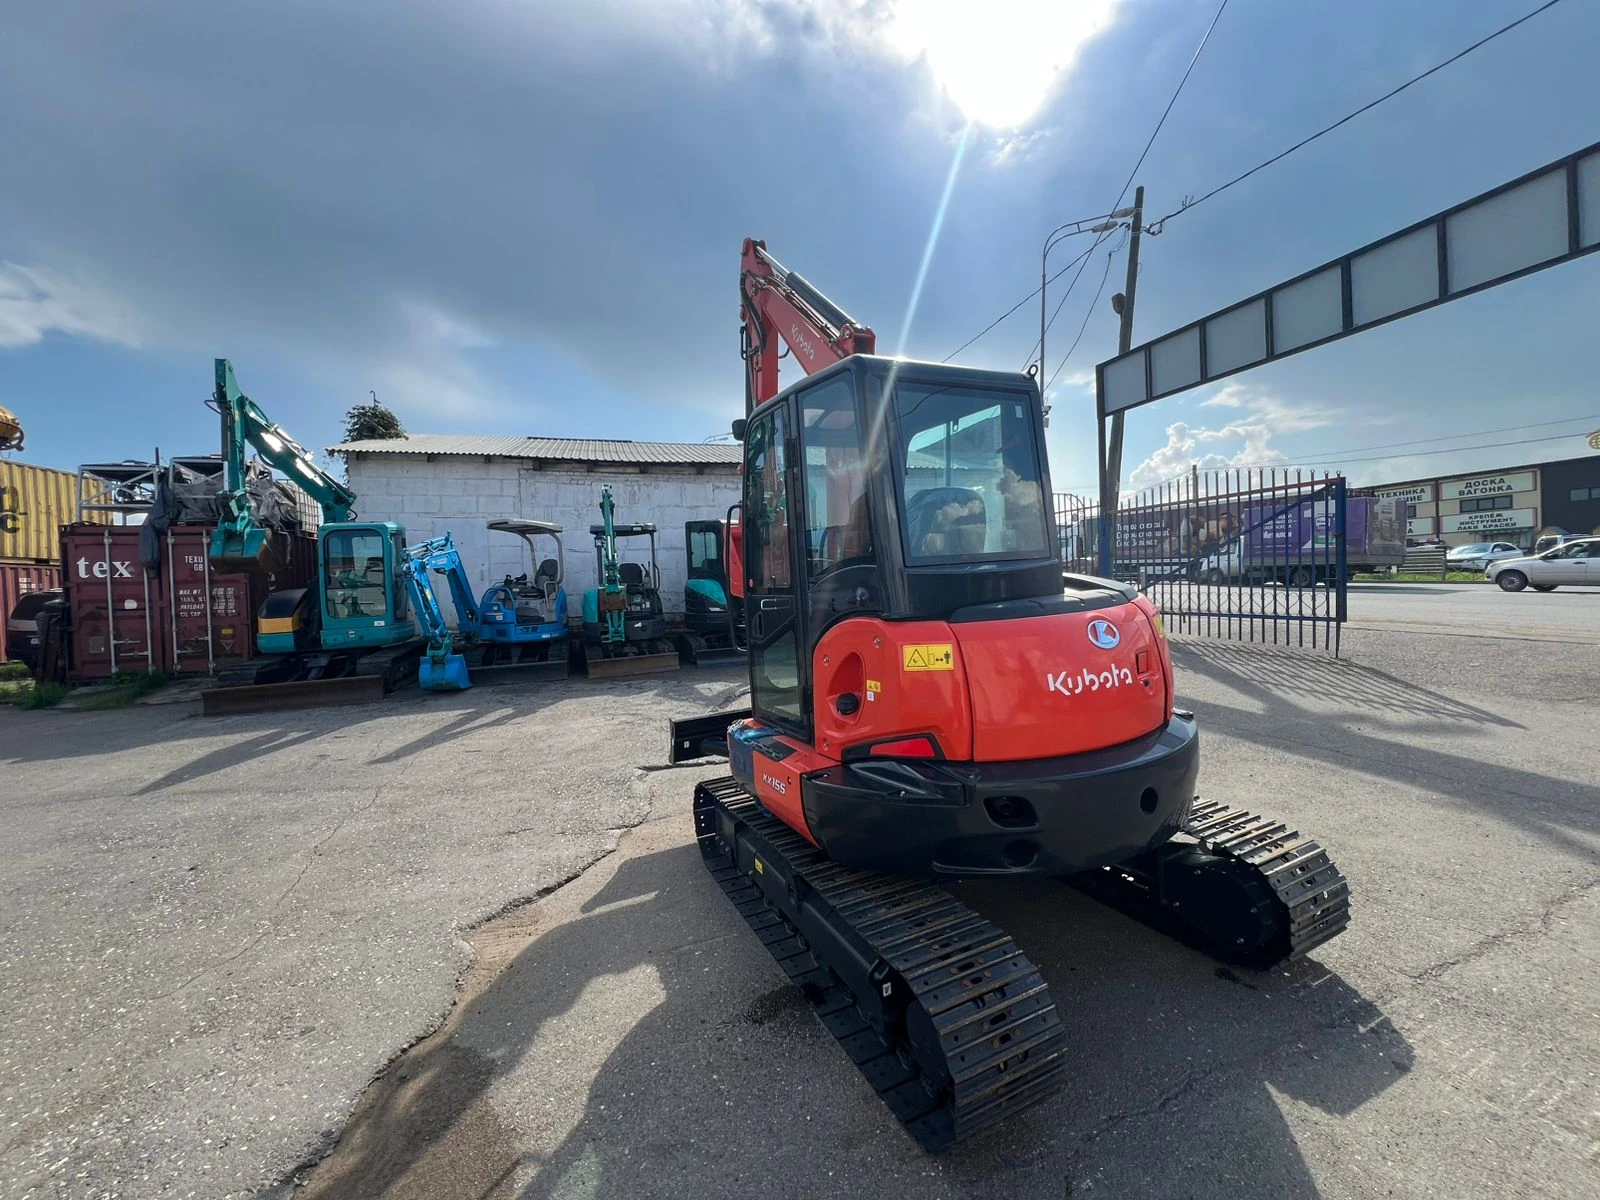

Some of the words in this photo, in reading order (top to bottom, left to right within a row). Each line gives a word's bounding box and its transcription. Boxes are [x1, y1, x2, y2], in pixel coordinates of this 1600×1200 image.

[791, 323, 814, 360] Kubota
[1464, 478, 1506, 489] ДОСКА
[1377, 488, 1426, 498] ТЕХНИКА
[1458, 485, 1513, 496] ВАГОНКА
[1459, 516, 1514, 526] ИНСТРУМЕНТ
[184, 555, 203, 563] TEXU
[76, 556, 133, 579] tex
[1047, 663, 1133, 696] Kubota
[762, 772, 786, 795] KX155
